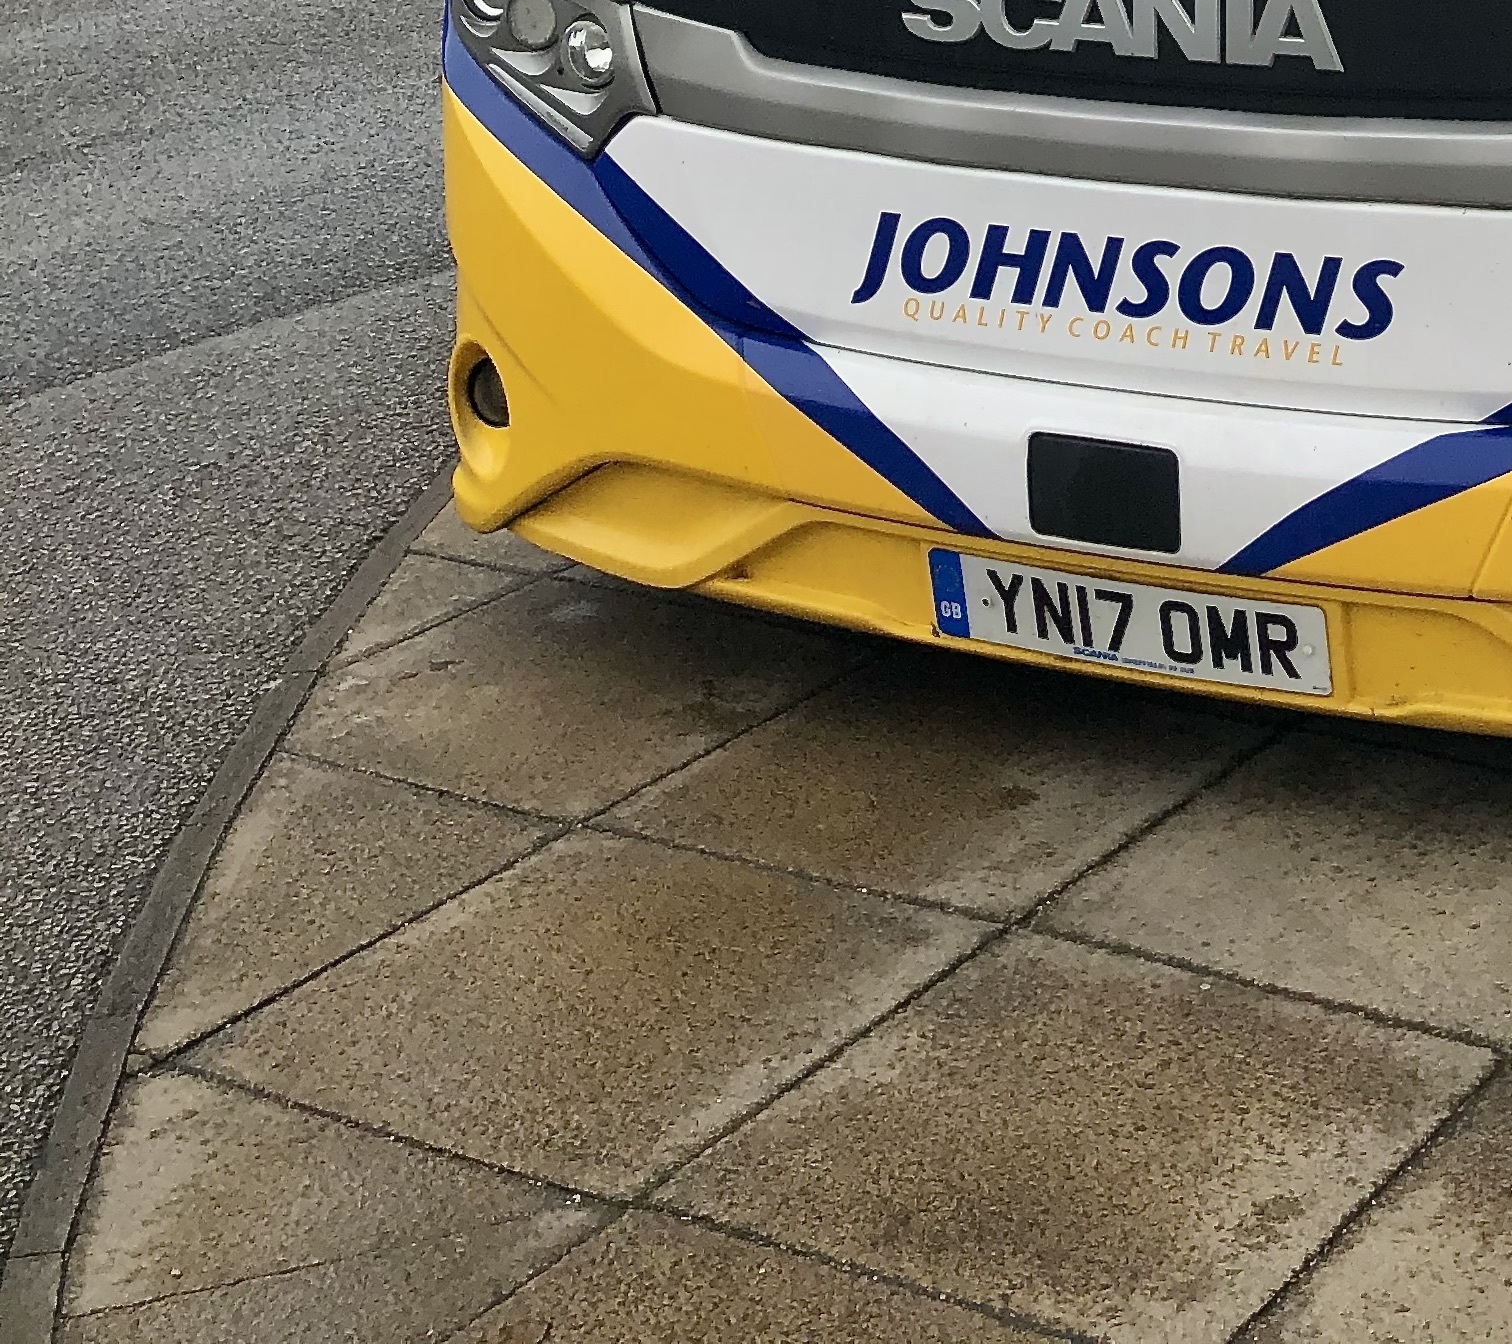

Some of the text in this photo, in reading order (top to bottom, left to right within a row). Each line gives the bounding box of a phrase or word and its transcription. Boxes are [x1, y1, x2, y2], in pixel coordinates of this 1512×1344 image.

[851, 210, 1405, 341] JOHNSONS
[903, 296, 1345, 367] QUALITY COACH TRAVEL
[940, 600, 962, 619] GB
[985, 568, 1302, 680] YN17 OMR
